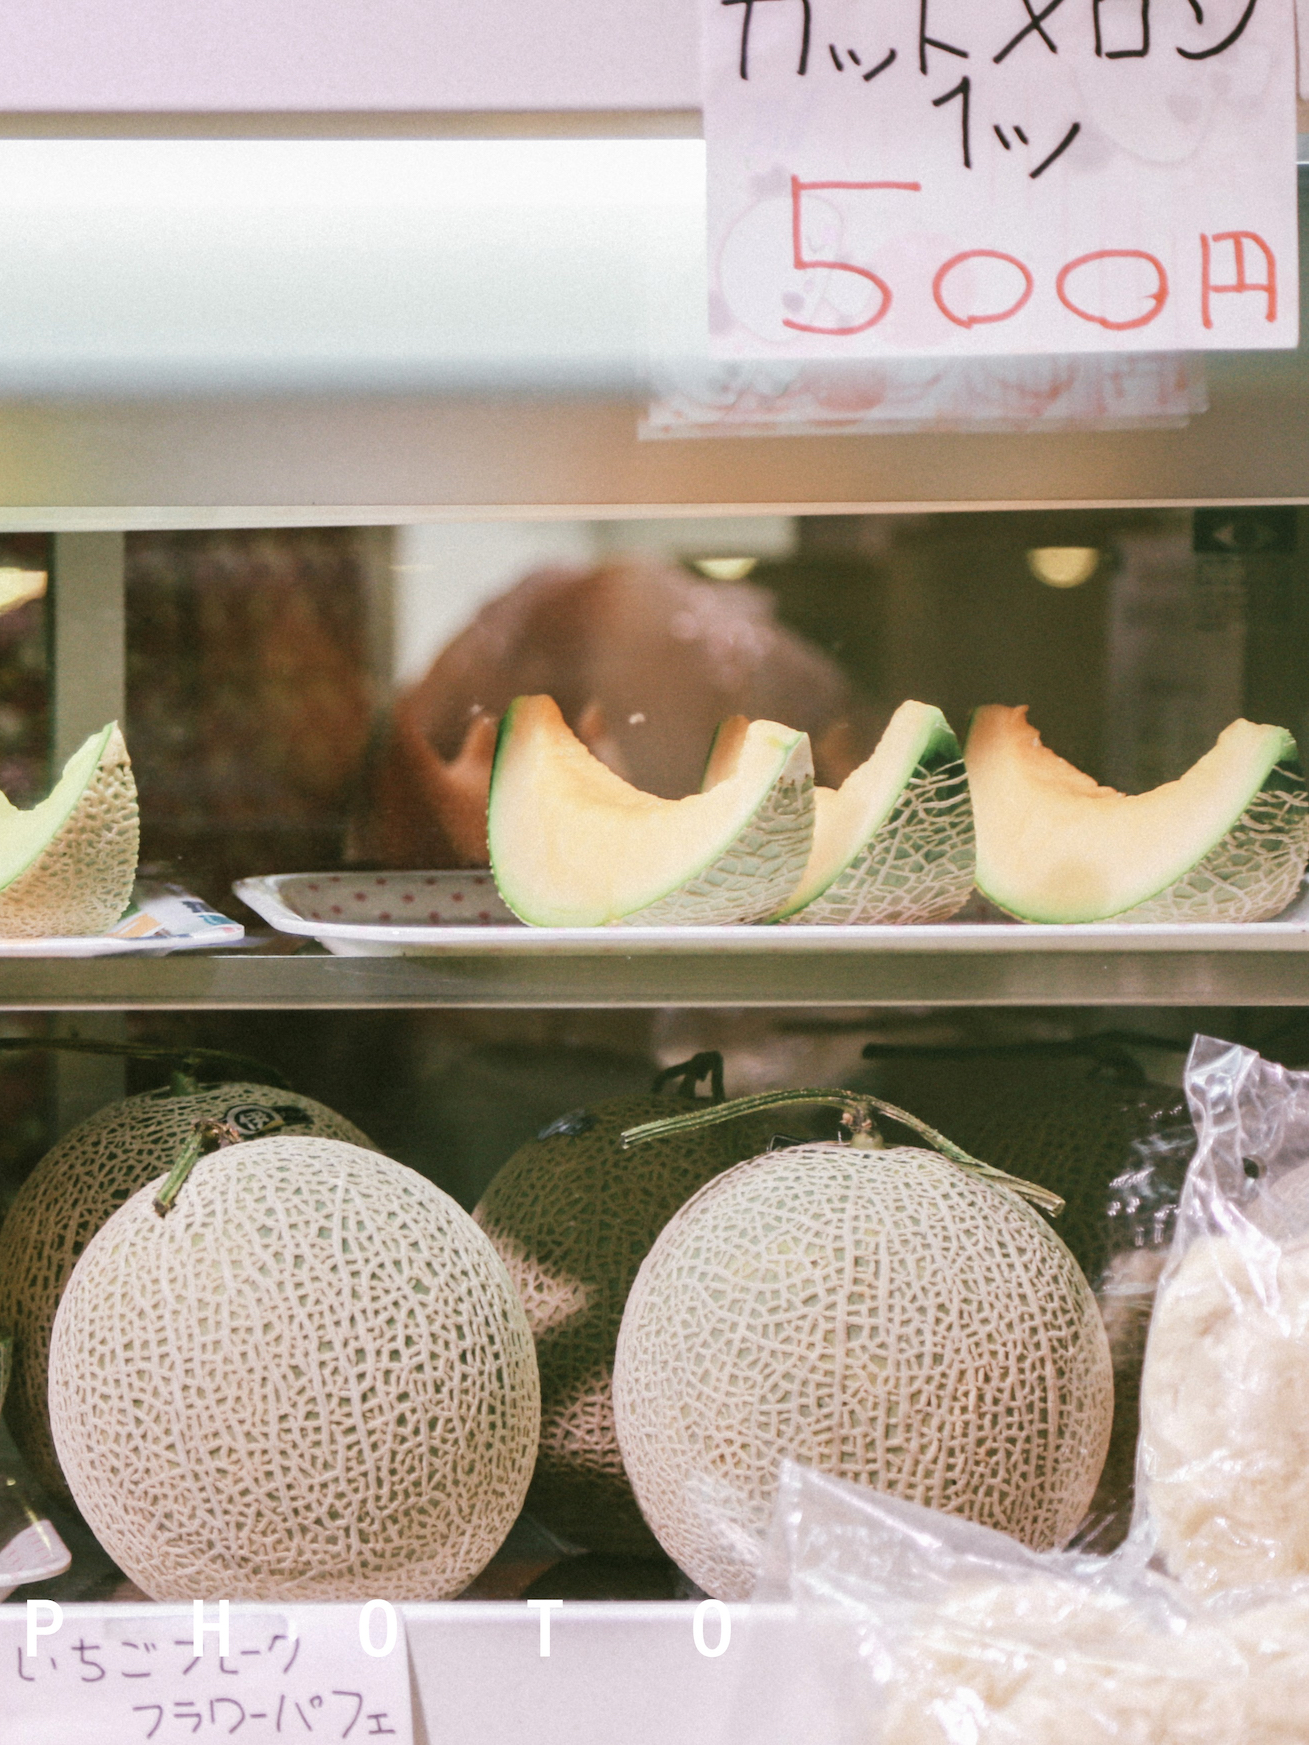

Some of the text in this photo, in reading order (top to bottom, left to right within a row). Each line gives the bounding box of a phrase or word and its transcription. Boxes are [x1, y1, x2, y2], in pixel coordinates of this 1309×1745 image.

[720, 0, 1257, 82] カットメロン
[782, 173, 1279, 336] 500円
[132, 1689, 397, 1740] フラワーパフェ
